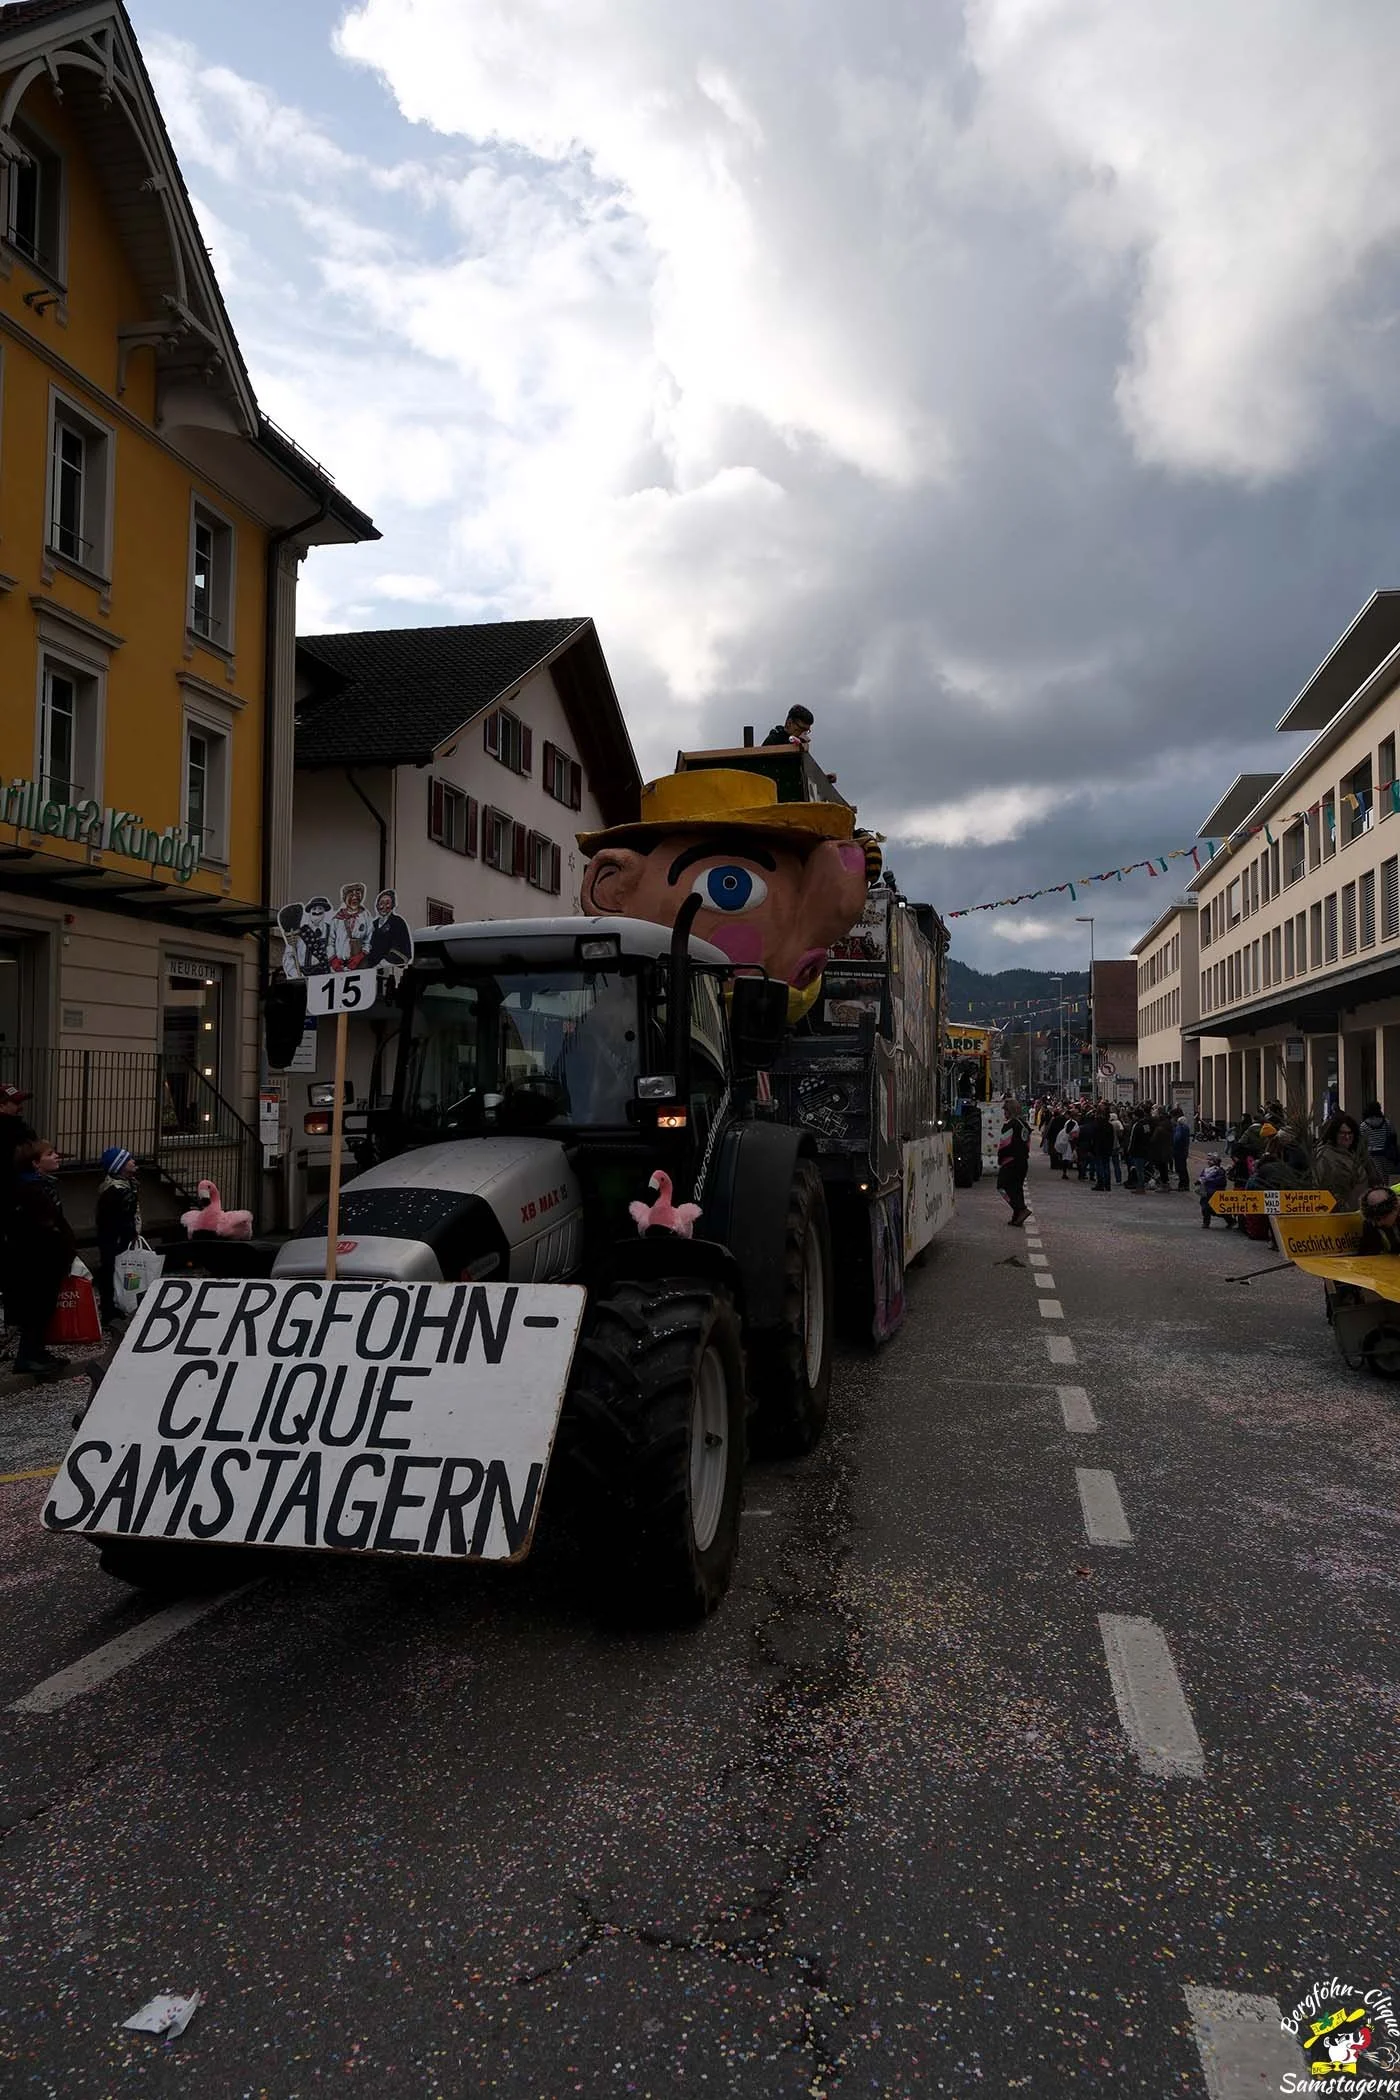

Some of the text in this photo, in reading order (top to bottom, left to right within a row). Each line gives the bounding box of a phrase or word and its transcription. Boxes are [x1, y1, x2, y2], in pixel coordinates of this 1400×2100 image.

[0, 778, 201, 882] rillen? Kündig!
[170, 960, 216, 978] NEUROTH
[321, 975, 362, 1010] 15
[944, 1036, 982, 1051] ARDE
[538, 1190, 560, 1213] MAX
[1219, 1202, 1249, 1213] Sattel
[1264, 1199, 1280, 1207] WALD
[1286, 1202, 1313, 1213] Sattel
[1288, 1232, 1334, 1253] Geschickt
[132, 1279, 559, 1364] BERGFÖHN-
[158, 1359, 431, 1449] CLIQUE
[44, 1440, 542, 1555] SAMSTAGERN
